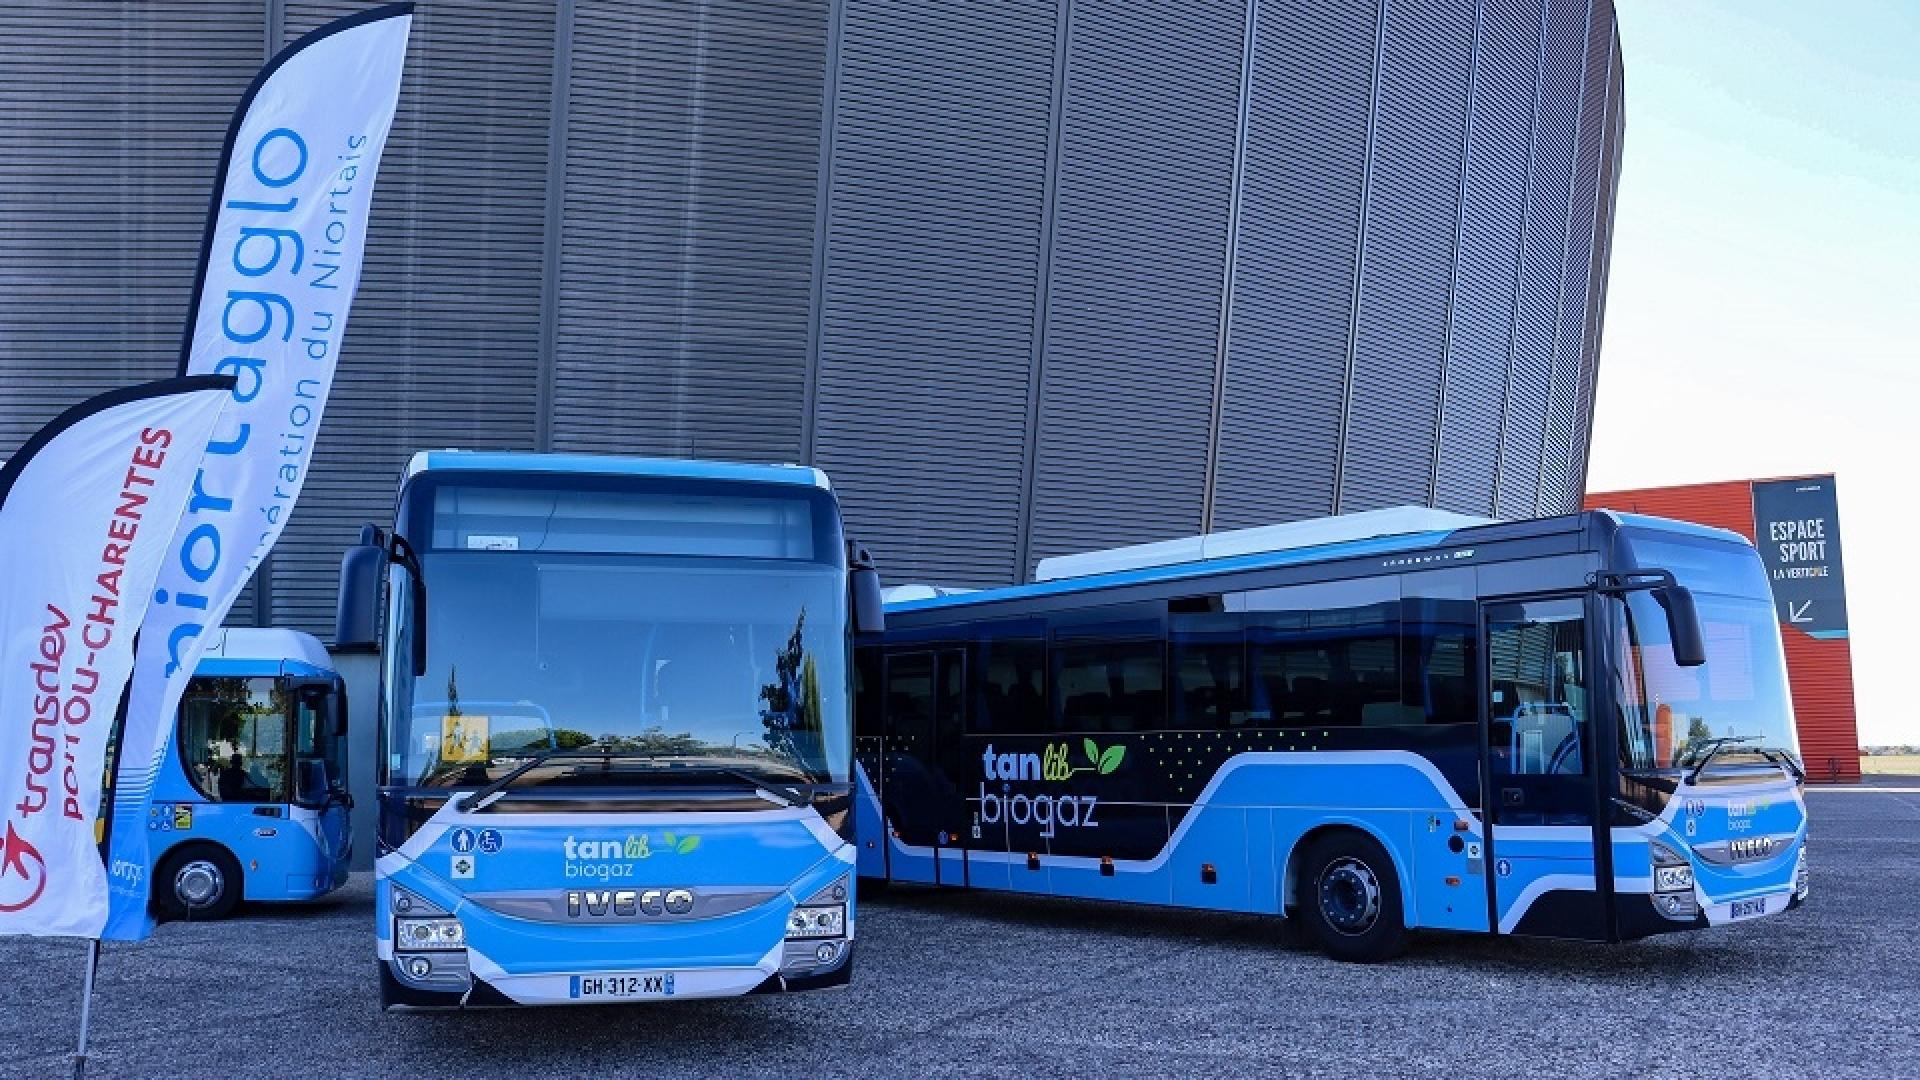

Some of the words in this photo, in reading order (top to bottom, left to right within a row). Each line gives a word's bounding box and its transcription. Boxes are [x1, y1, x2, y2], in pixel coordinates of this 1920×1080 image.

[309, 134, 367, 290] Niortais
[302, 311, 334, 360] du
[1769, 518, 1825, 541] ESPACE
[1779, 540, 1827, 563] SPORT
[16, 603, 71, 818] transdev
[979, 781, 1099, 839] biogaz
[564, 860, 634, 882] biogaz
[567, 889, 694, 918] IVECO
